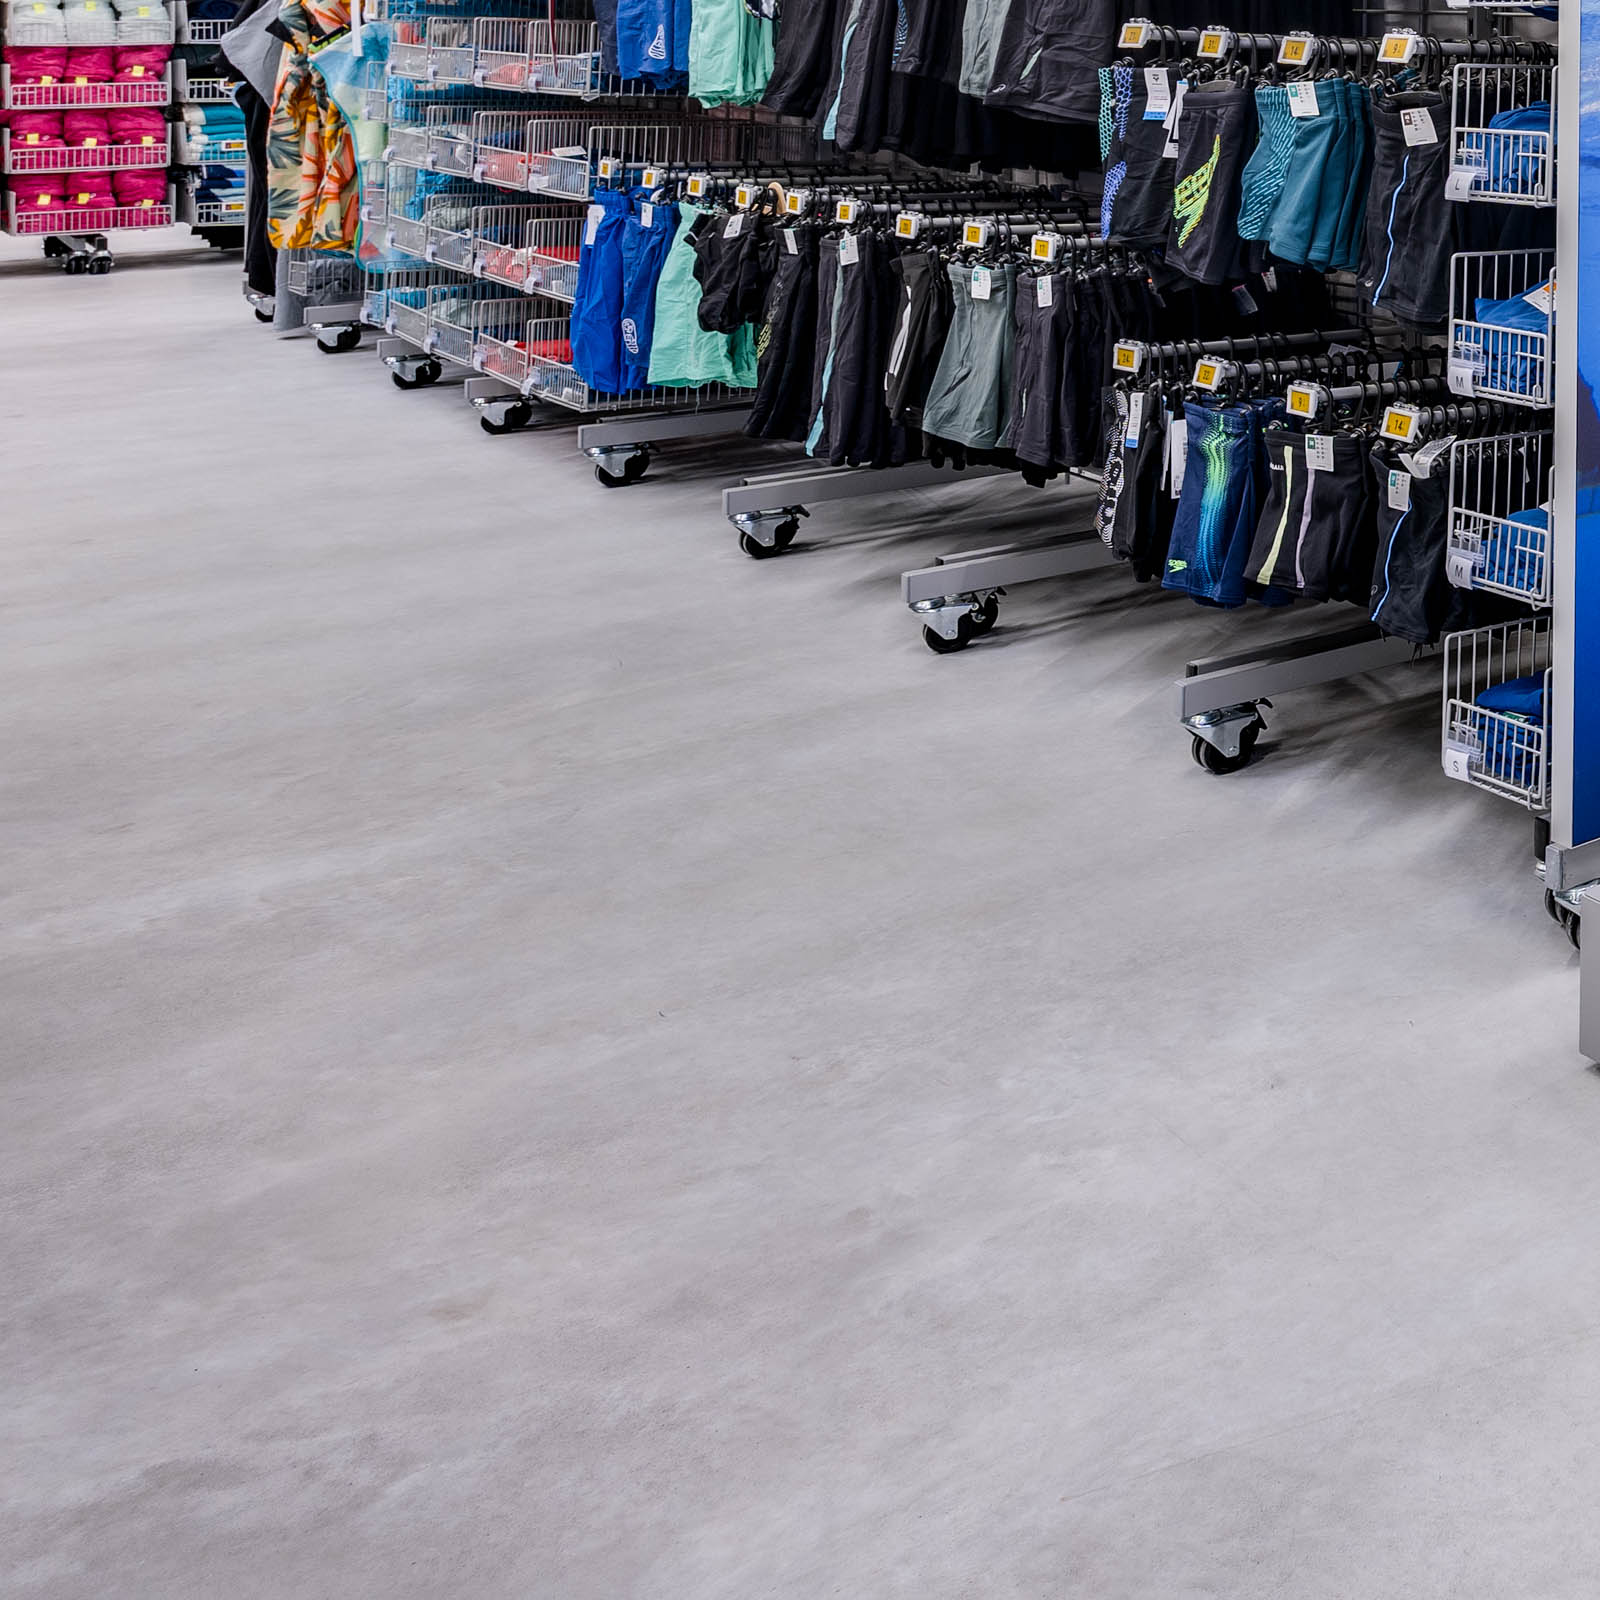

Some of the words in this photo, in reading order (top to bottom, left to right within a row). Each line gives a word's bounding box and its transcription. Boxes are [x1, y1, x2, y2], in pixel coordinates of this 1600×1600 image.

[1455, 375, 1464, 390] M
[1454, 564, 1464, 579] M
[1452, 761, 1459, 773] S
